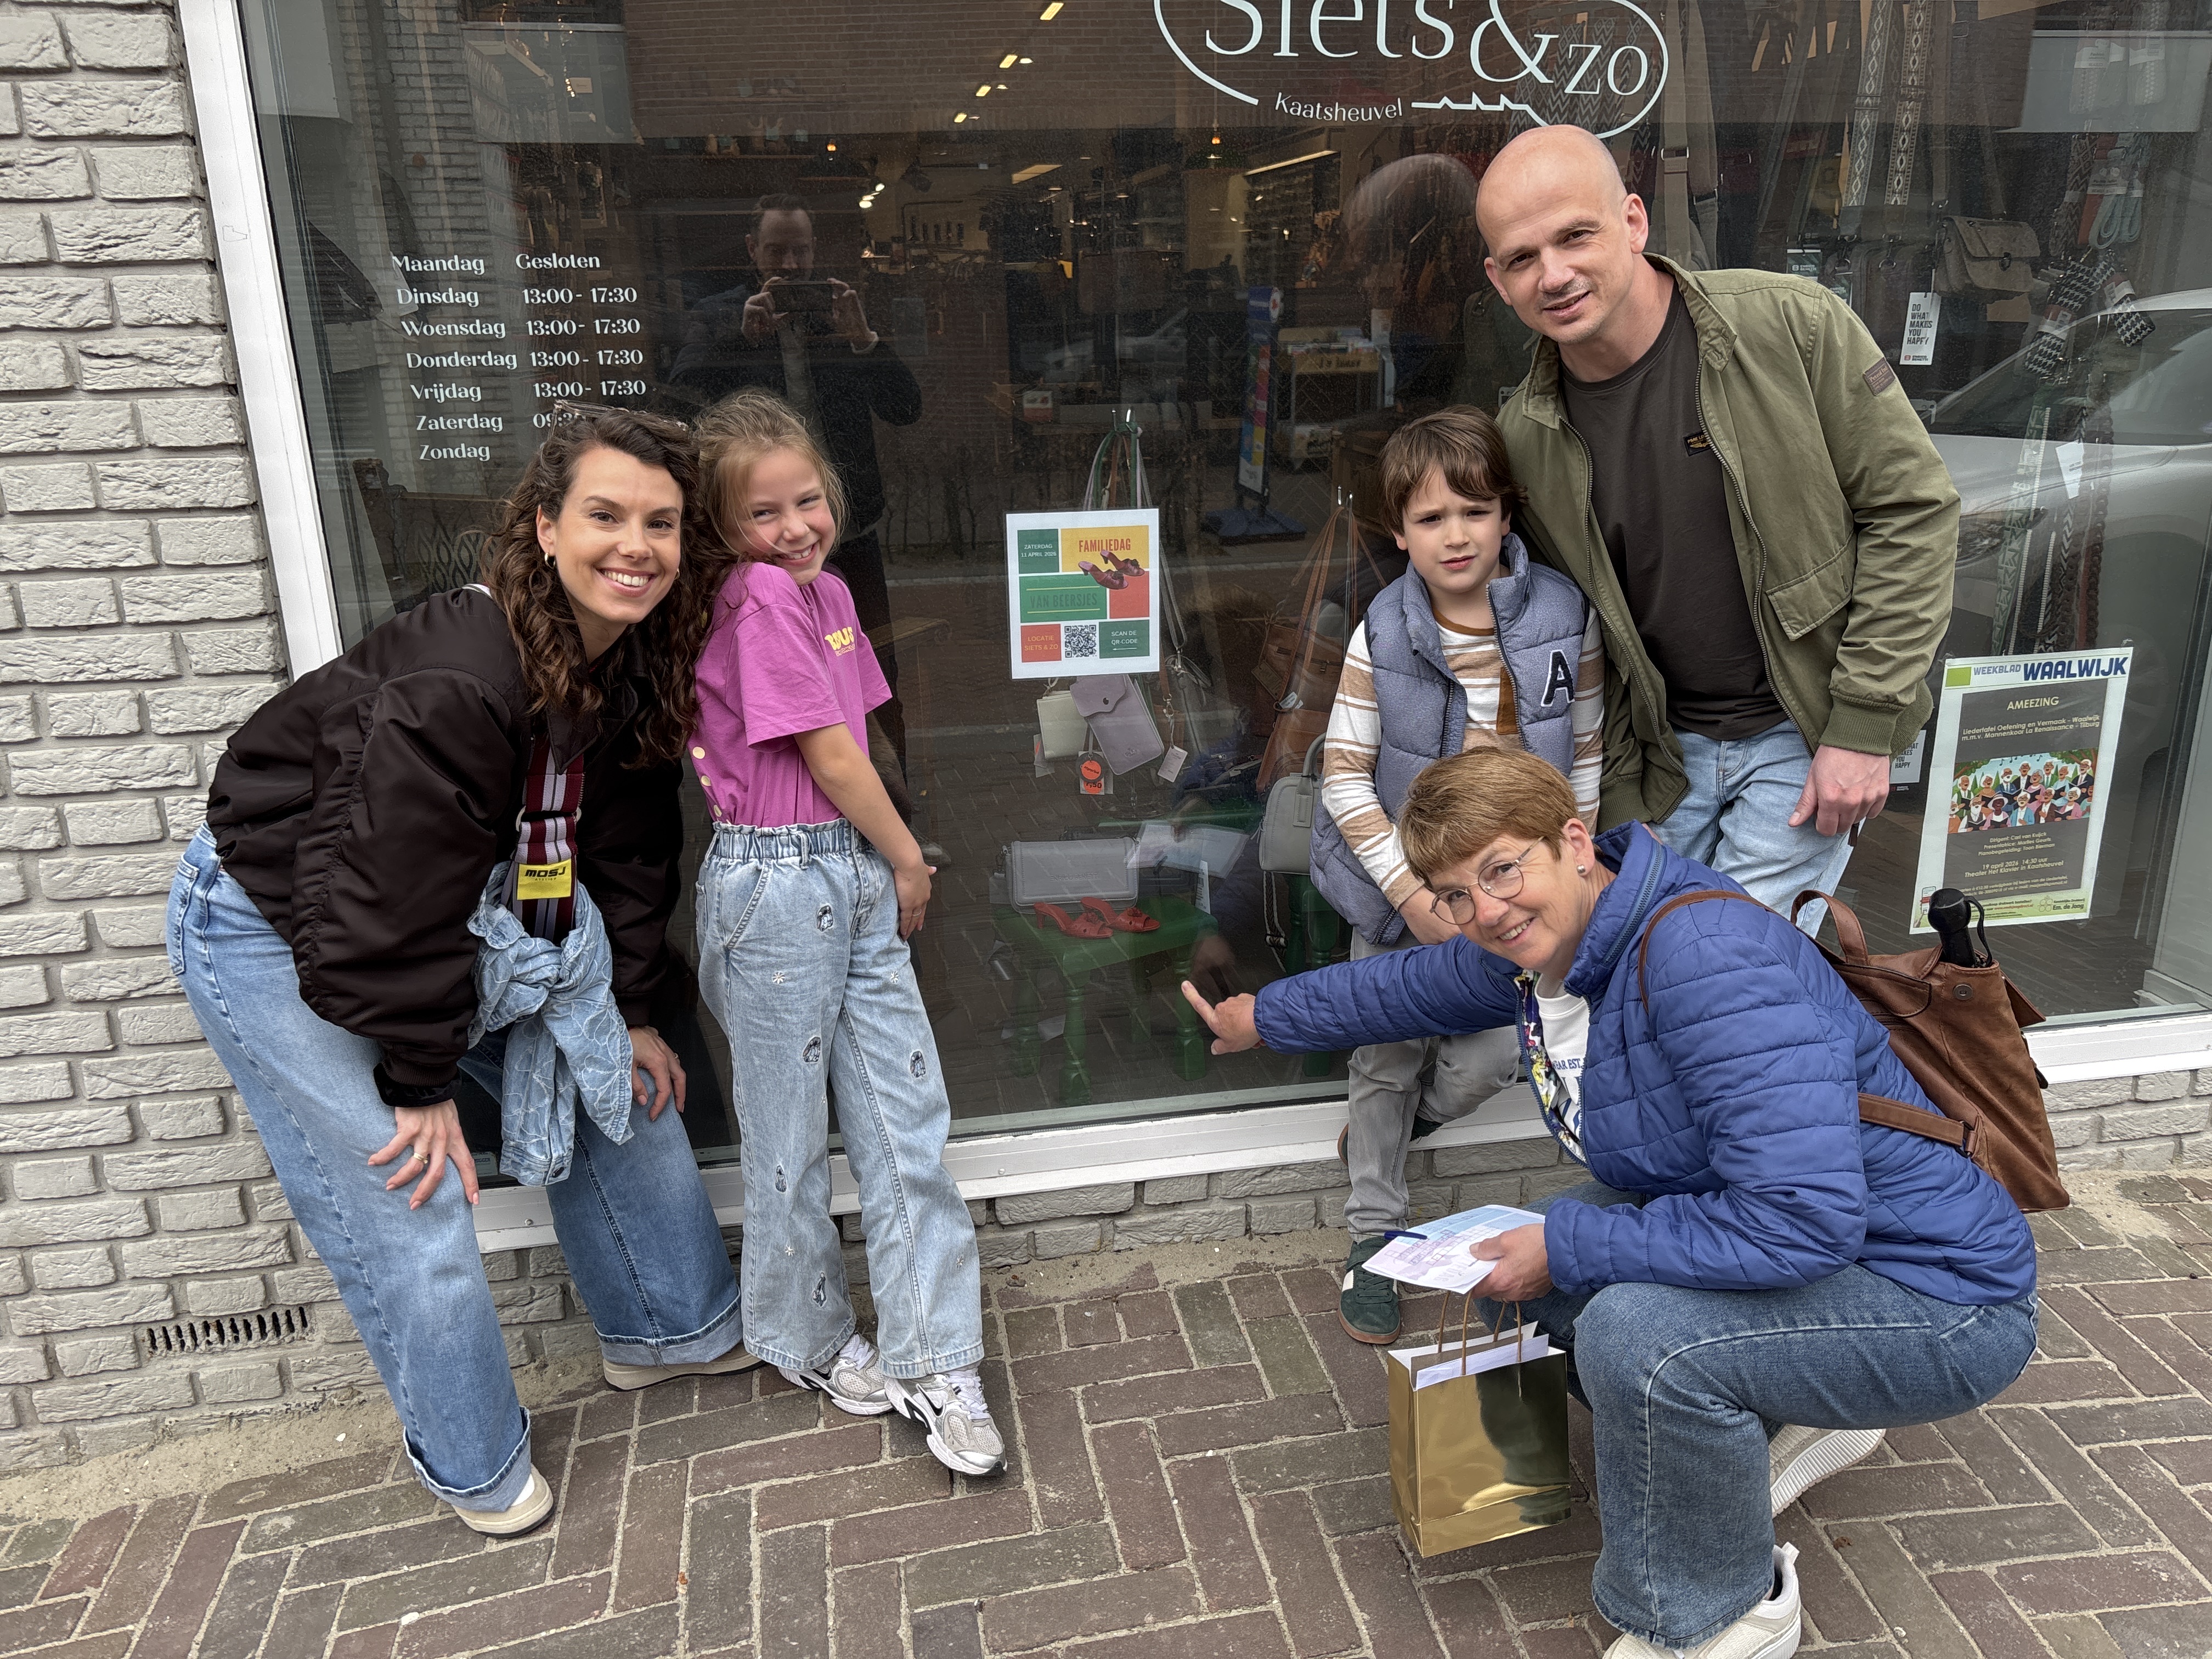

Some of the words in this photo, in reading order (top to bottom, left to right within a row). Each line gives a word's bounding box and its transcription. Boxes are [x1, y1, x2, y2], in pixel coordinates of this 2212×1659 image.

[1276, 92, 1403, 122] Kaatsheuvel
[393, 255, 485, 275] Maandag
[516, 253, 601, 270] Gesloten
[397, 288, 479, 307] Dinsdag
[590, 287, 637, 303] 17:30
[402, 320, 506, 338] Woensdag
[594, 319, 640, 334] 17:30
[407, 351, 517, 370] Donderdag
[597, 350, 643, 365] 17:30
[411, 383, 482, 403] Vrijdag
[600, 381, 646, 396] 17:30
[416, 414, 503, 432] Zaterdag
[420, 443, 490, 461] Zondag
[1079, 538, 1131, 552] FAMILIEDAG
[1030, 596, 1049, 608] VAN
[1052, 593, 1098, 607] BEERSJES
[1973, 664, 2021, 675] WEEKBLAD
[2023, 657, 2129, 681] WAALWIJK
[1541, 650, 1575, 707] A
[2006, 696, 2059, 711] AMEEZING
[1984, 730, 2024, 738] Mannenkoor
[2034, 724, 2074, 733] Renaissance
[2080, 721, 2100, 729] Tilburg
[2037, 718, 2066, 727] Vermaak
[2027, 860, 2064, 870] Kaatsheuvel
